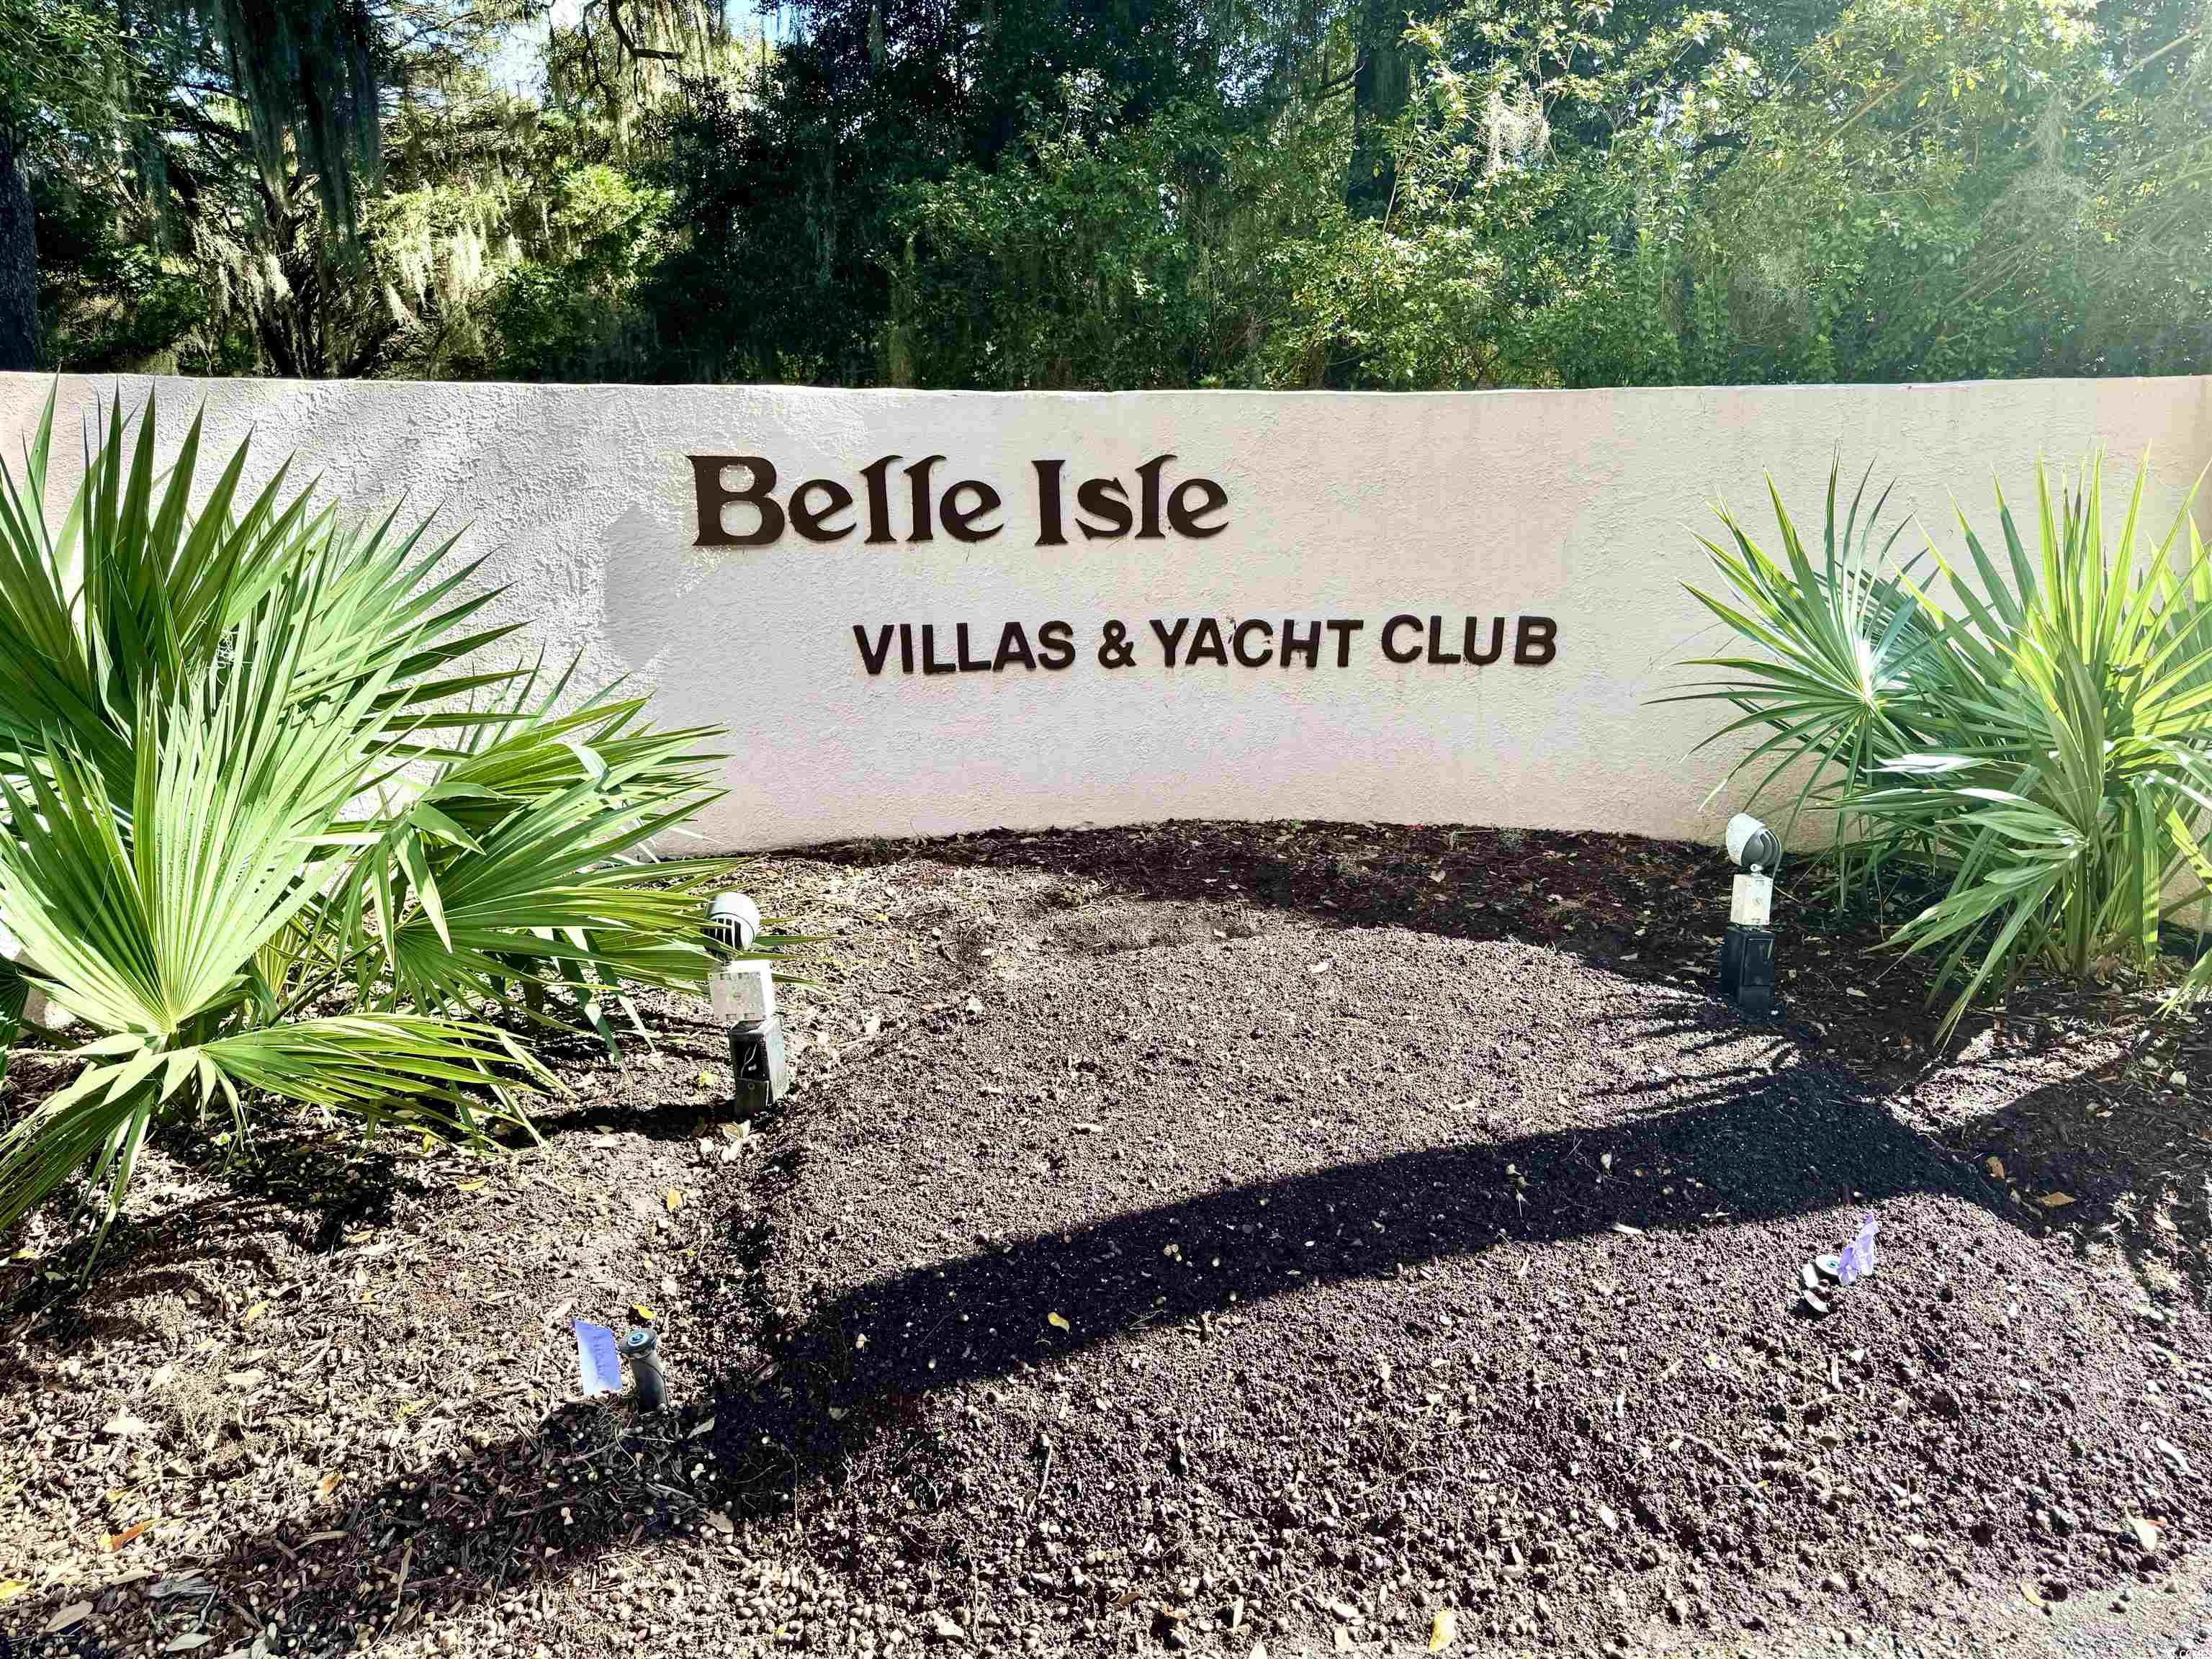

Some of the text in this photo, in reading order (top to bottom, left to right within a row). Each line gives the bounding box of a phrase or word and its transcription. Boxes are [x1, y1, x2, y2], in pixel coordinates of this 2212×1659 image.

[684, 454, 1230, 547] Belle Isle
[851, 613, 1558, 676] VILLAS & YACHT CLUB
